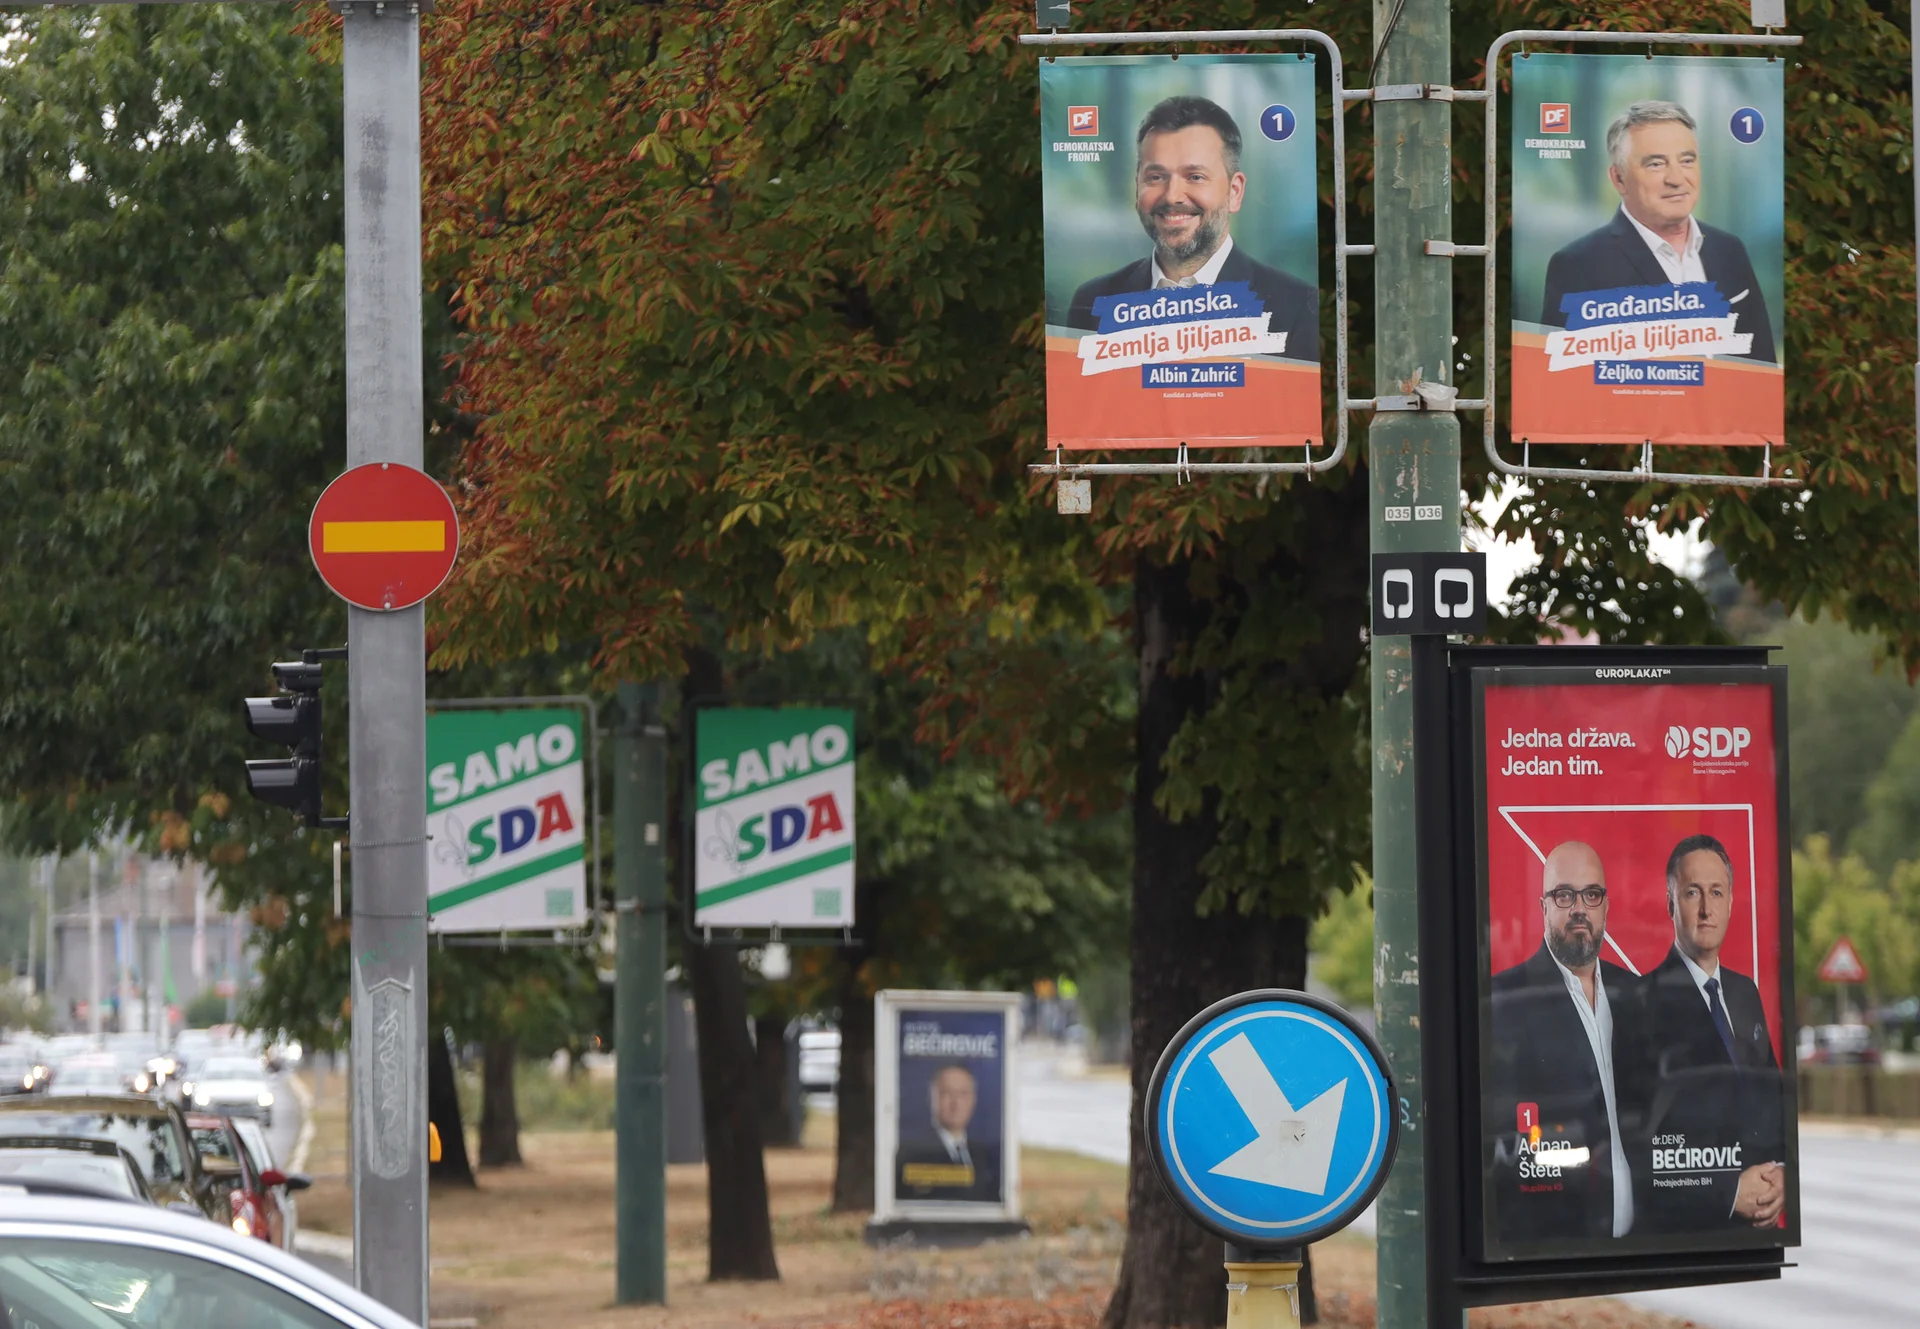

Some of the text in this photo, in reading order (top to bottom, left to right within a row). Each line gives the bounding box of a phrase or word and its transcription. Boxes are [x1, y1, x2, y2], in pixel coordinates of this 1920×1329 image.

[1072, 111, 1094, 127] DF
[1271, 112, 1283, 132] 1
[1544, 108, 1565, 124] DF
[1740, 115, 1753, 135] 1
[1053, 141, 1115, 152] DEMOKRATSKA
[1525, 138, 1586, 149] DEMOKRATSKA
[1539, 149, 1571, 159] FRONTA
[1067, 152, 1101, 162] FRONTA
[1113, 291, 1239, 323] Građanska.
[1581, 291, 1705, 321] Građanska.
[1095, 325, 1258, 360] Zemlja ljiljana.
[1562, 324, 1723, 356] Zemlja ljiljana.
[1149, 366, 1238, 383] Albin Zuhrić
[1598, 361, 1700, 384] Željko Komšić
[1387, 507, 1442, 519] 035 036
[1501, 727, 1636, 749] Jedna država.
[1692, 726, 1751, 759] SDP
[428, 723, 577, 806] SAMO
[700, 724, 850, 801] SAMO
[1501, 755, 1604, 776] Jedan tim.
[467, 790, 575, 867] SDA
[737, 790, 845, 863] SDA
[1523, 1109, 1532, 1127] 1
[1518, 1137, 1572, 1155] Adnan
[1652, 1141, 1742, 1170] BEĆIROVIĆ
